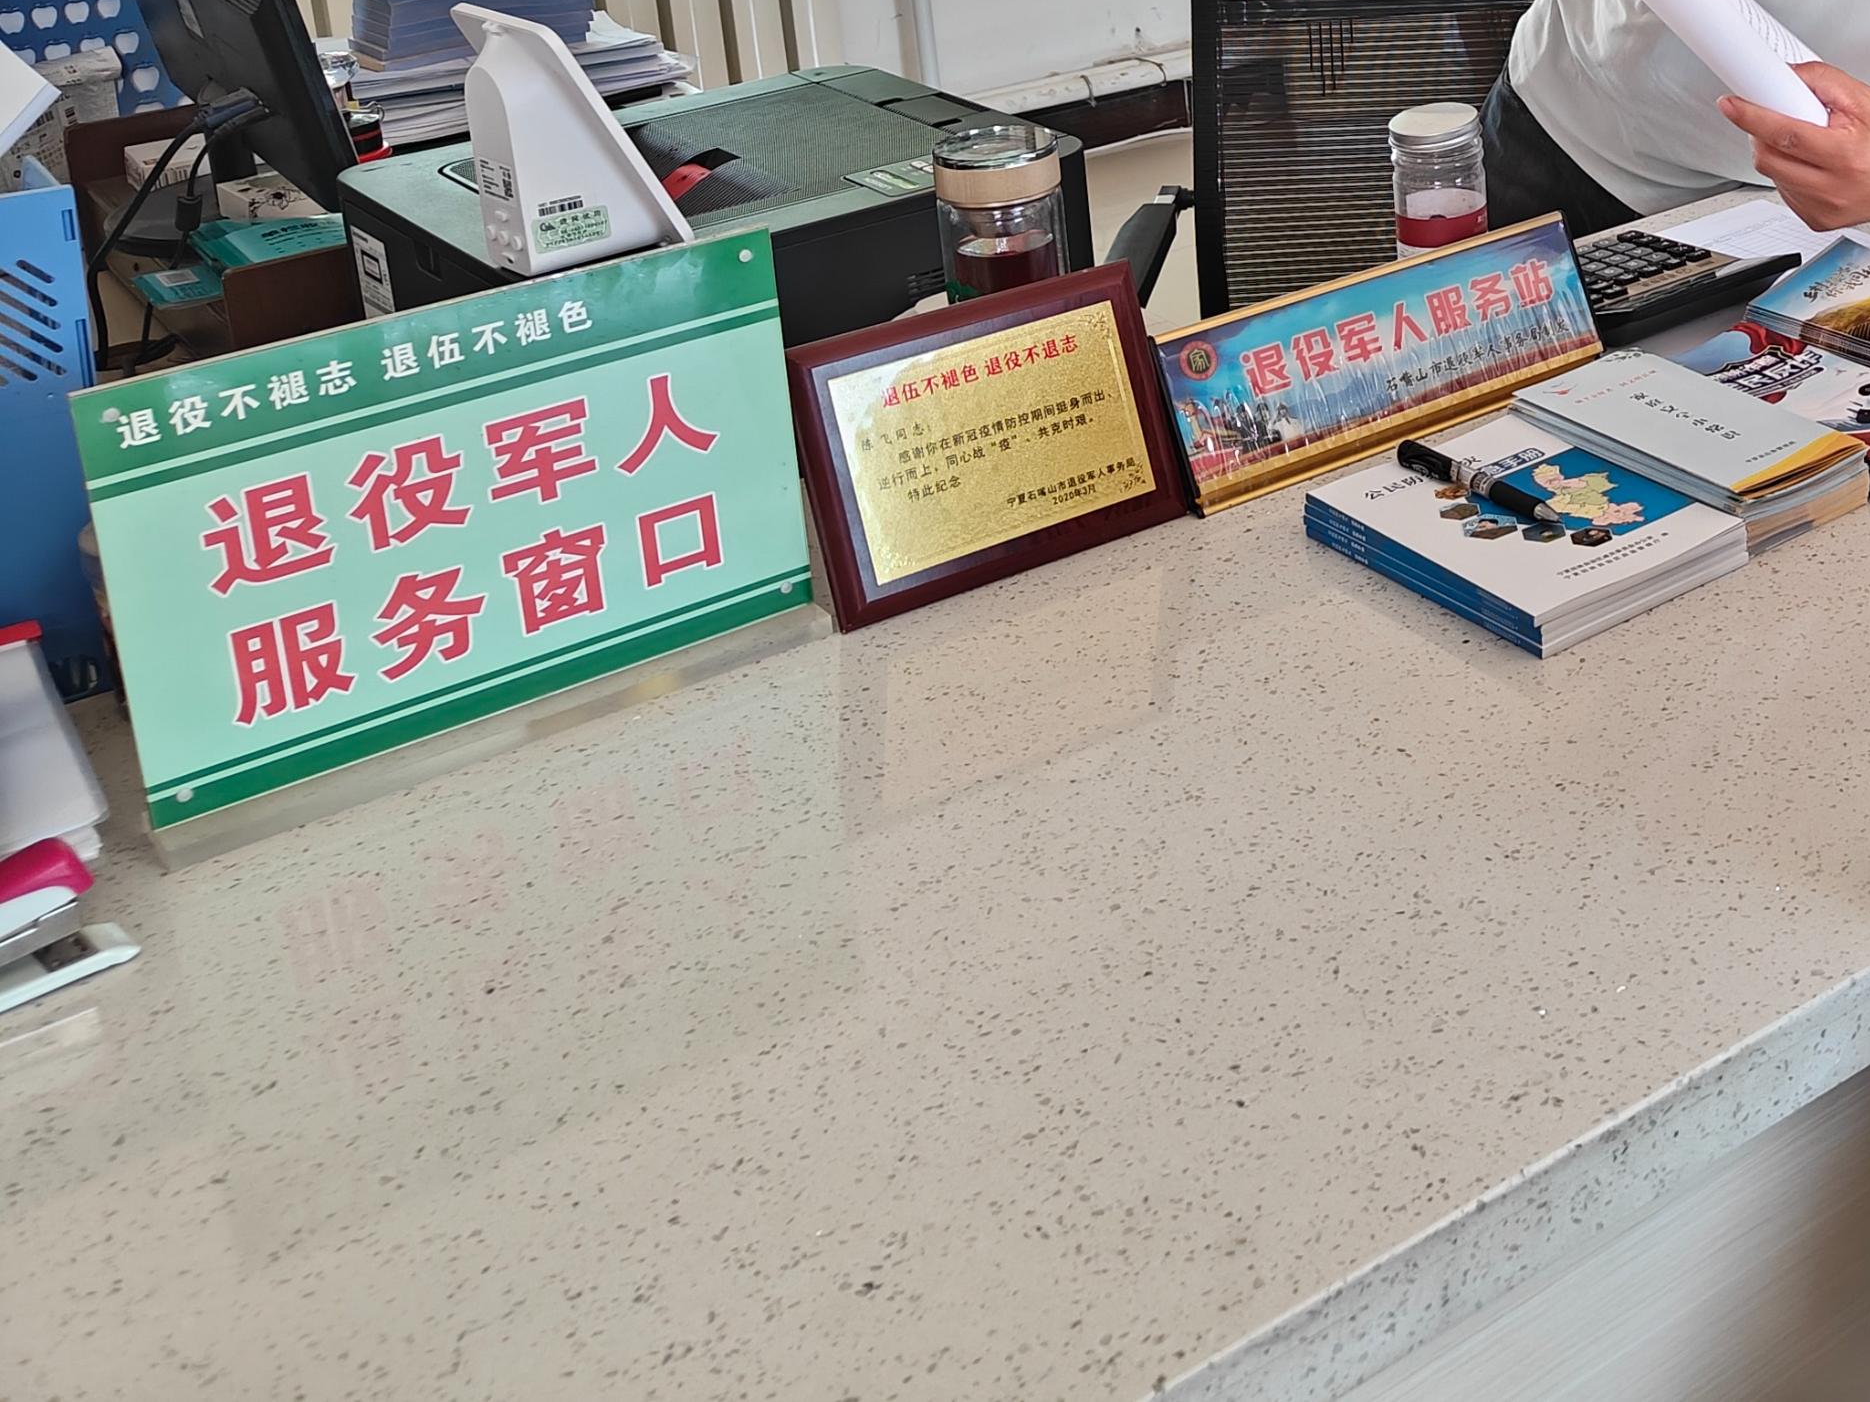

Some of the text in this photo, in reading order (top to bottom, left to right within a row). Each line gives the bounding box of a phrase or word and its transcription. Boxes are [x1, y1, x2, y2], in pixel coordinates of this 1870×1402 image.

[116, 301, 594, 449] 退役不褪志 退伍不褪色
[882, 334, 1079, 408] 退伍不褪色 退役不退志
[1240, 258, 1555, 398] 退役军人服务站
[201, 371, 719, 598] 退役军人
[907, 475, 962, 502] 特此纪念
[229, 493, 725, 727] 服务窗口
